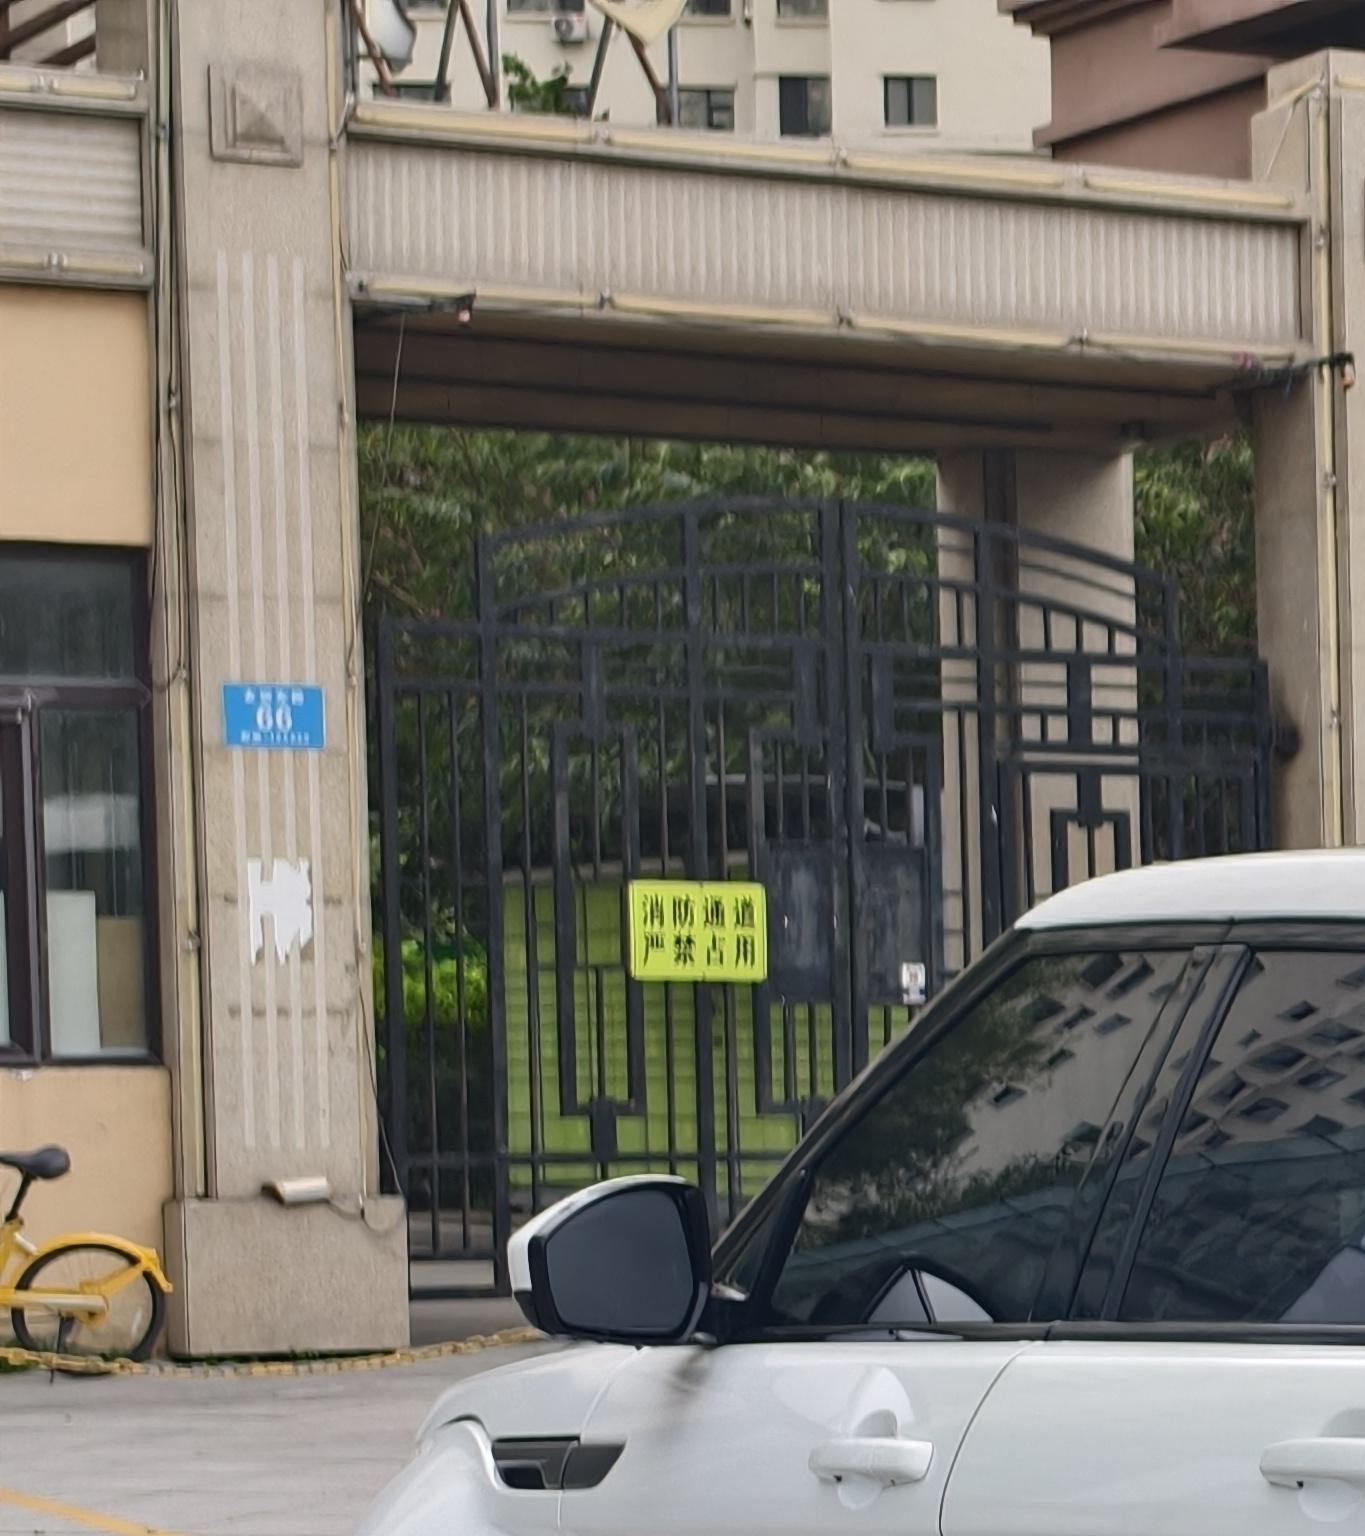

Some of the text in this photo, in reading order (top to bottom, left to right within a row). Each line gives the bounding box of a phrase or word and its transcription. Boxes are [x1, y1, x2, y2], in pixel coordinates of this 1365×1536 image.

[643, 893, 755, 929] 消防通道
[644, 930, 755, 969] 严禁占用
